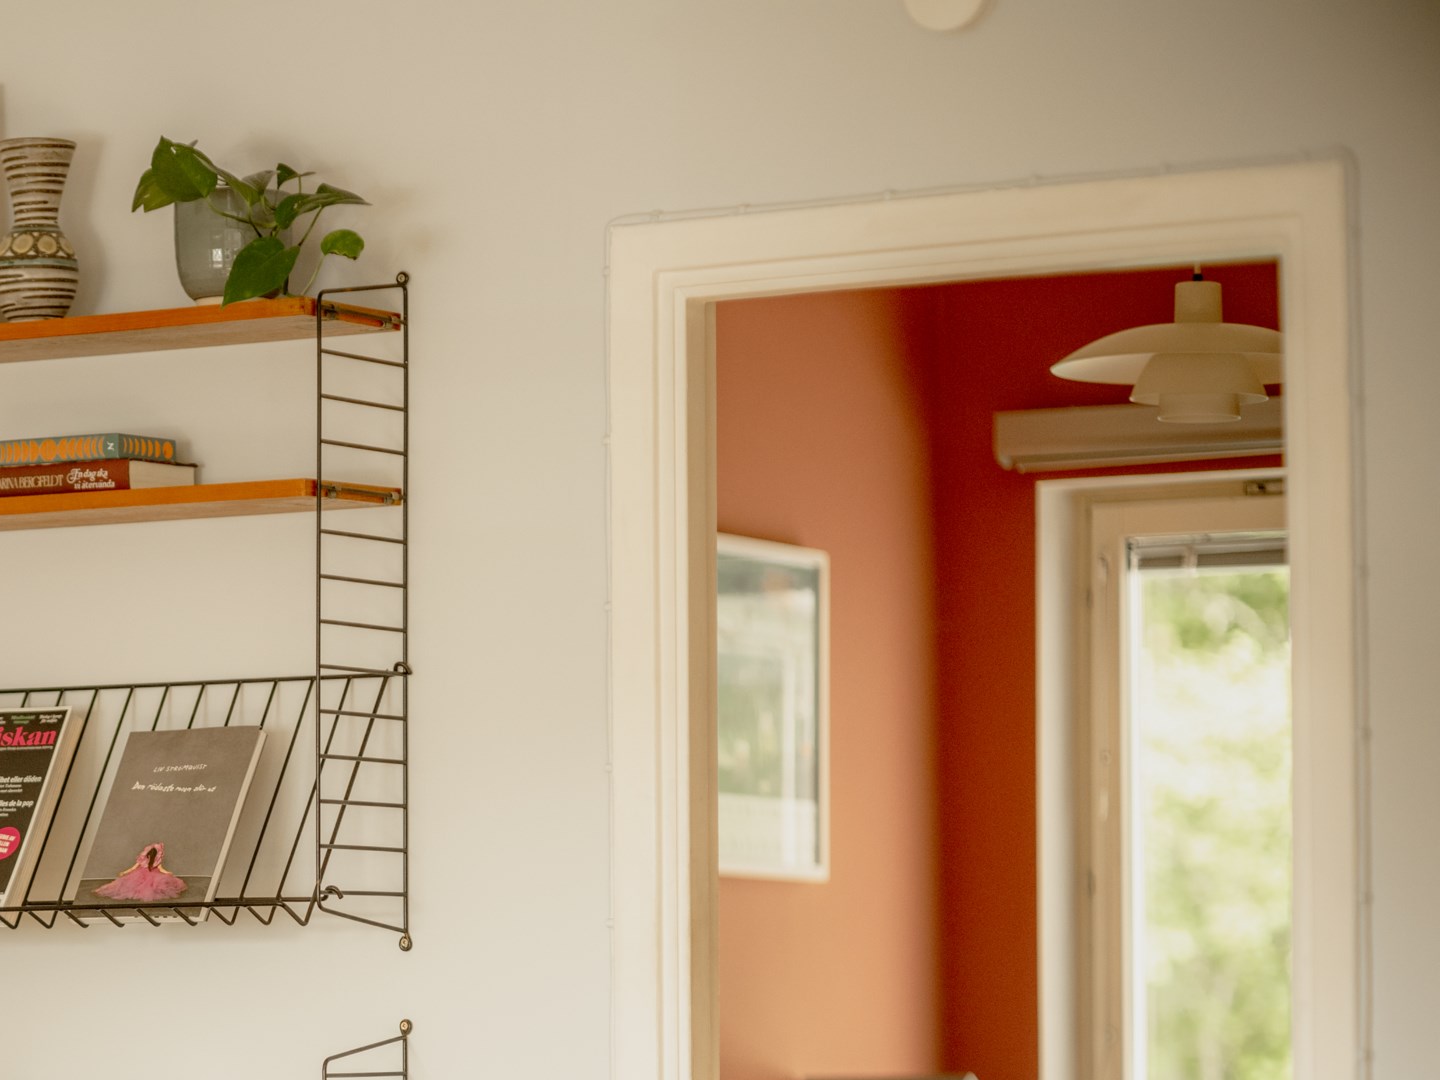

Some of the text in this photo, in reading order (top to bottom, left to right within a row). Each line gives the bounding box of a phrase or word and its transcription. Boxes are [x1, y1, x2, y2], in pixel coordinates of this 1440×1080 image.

[83, 468, 108, 480] dag ska
[19, 474, 64, 489] BERGFELDT
[81, 479, 115, 489] återvända
[23, 775, 42, 783] döden
[22, 800, 34, 808] pop
